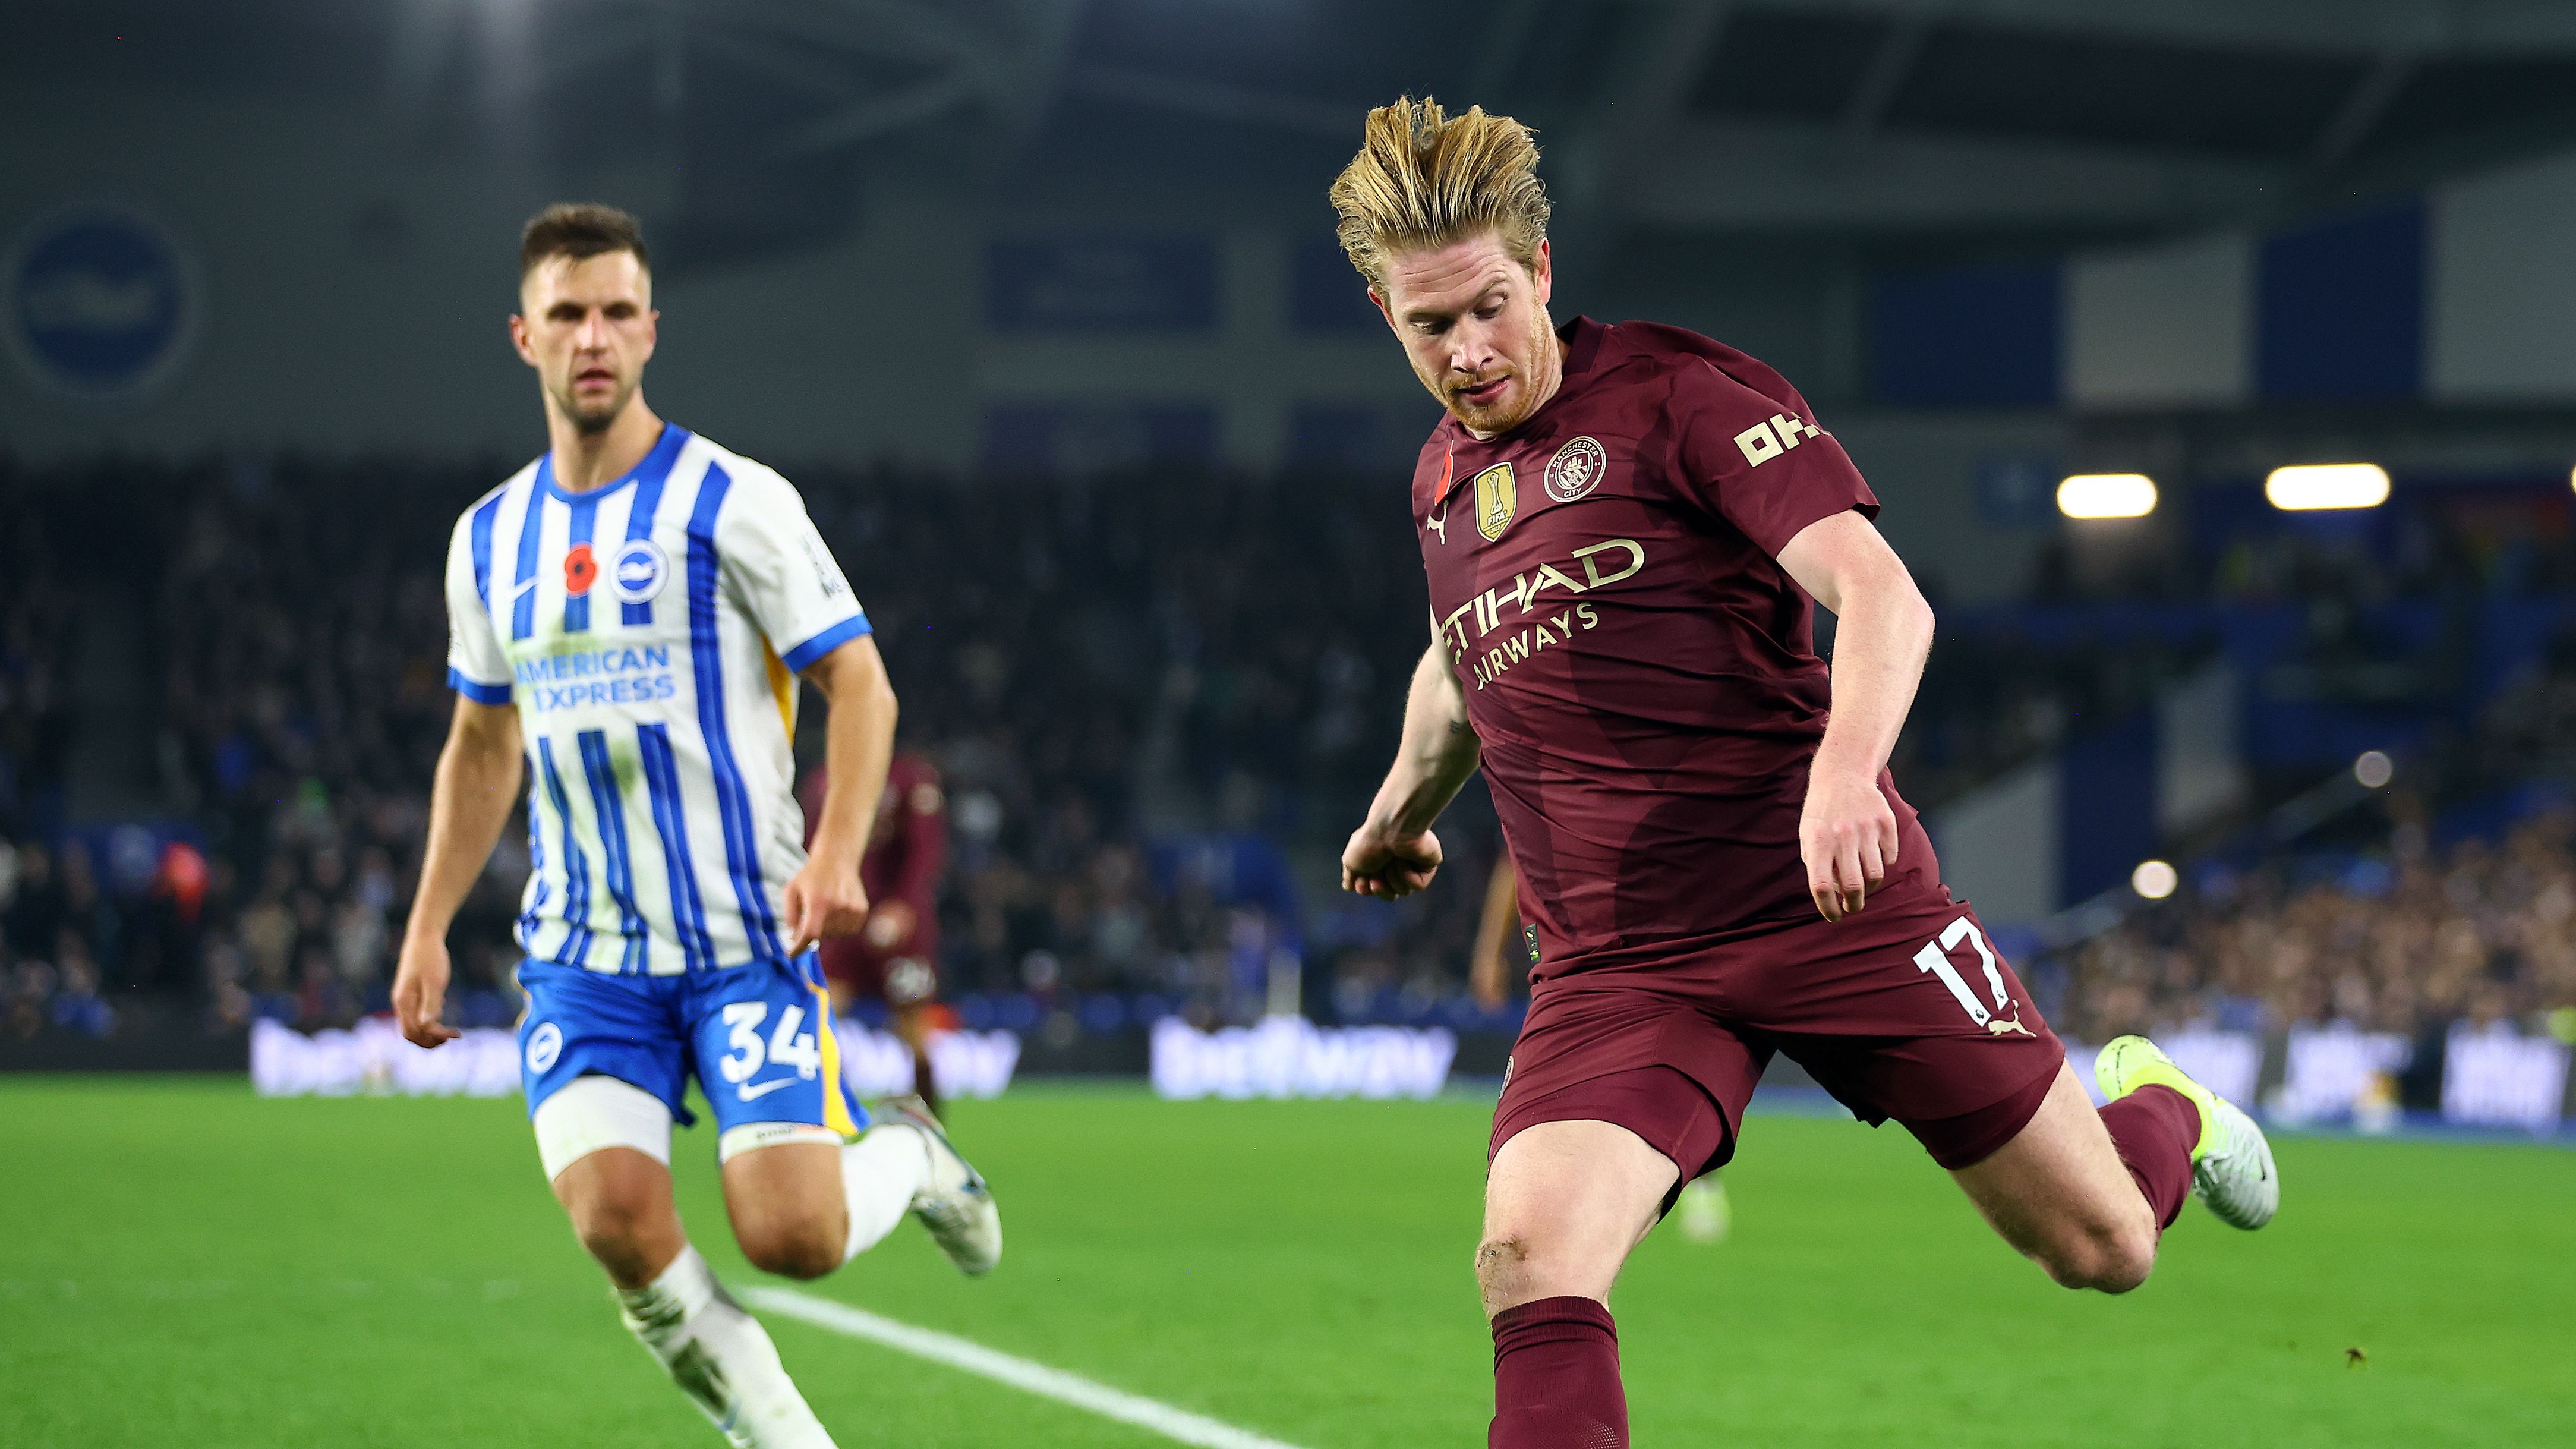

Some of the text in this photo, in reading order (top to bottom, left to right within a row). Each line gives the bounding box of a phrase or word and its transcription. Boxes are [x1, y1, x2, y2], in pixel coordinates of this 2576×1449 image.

[1552, 442, 1598, 468] MANCHESTER
[1733, 412, 1831, 468] OK
[1563, 487, 1582, 497] CITY
[1487, 511, 1506, 527] FIFA
[516, 644, 669, 682] AMERICAN
[1474, 601, 1598, 691] AIRWAYS
[534, 674, 676, 711] EXPRESS
[1912, 915, 2010, 1028] 17
[719, 1001, 822, 1081] 34
